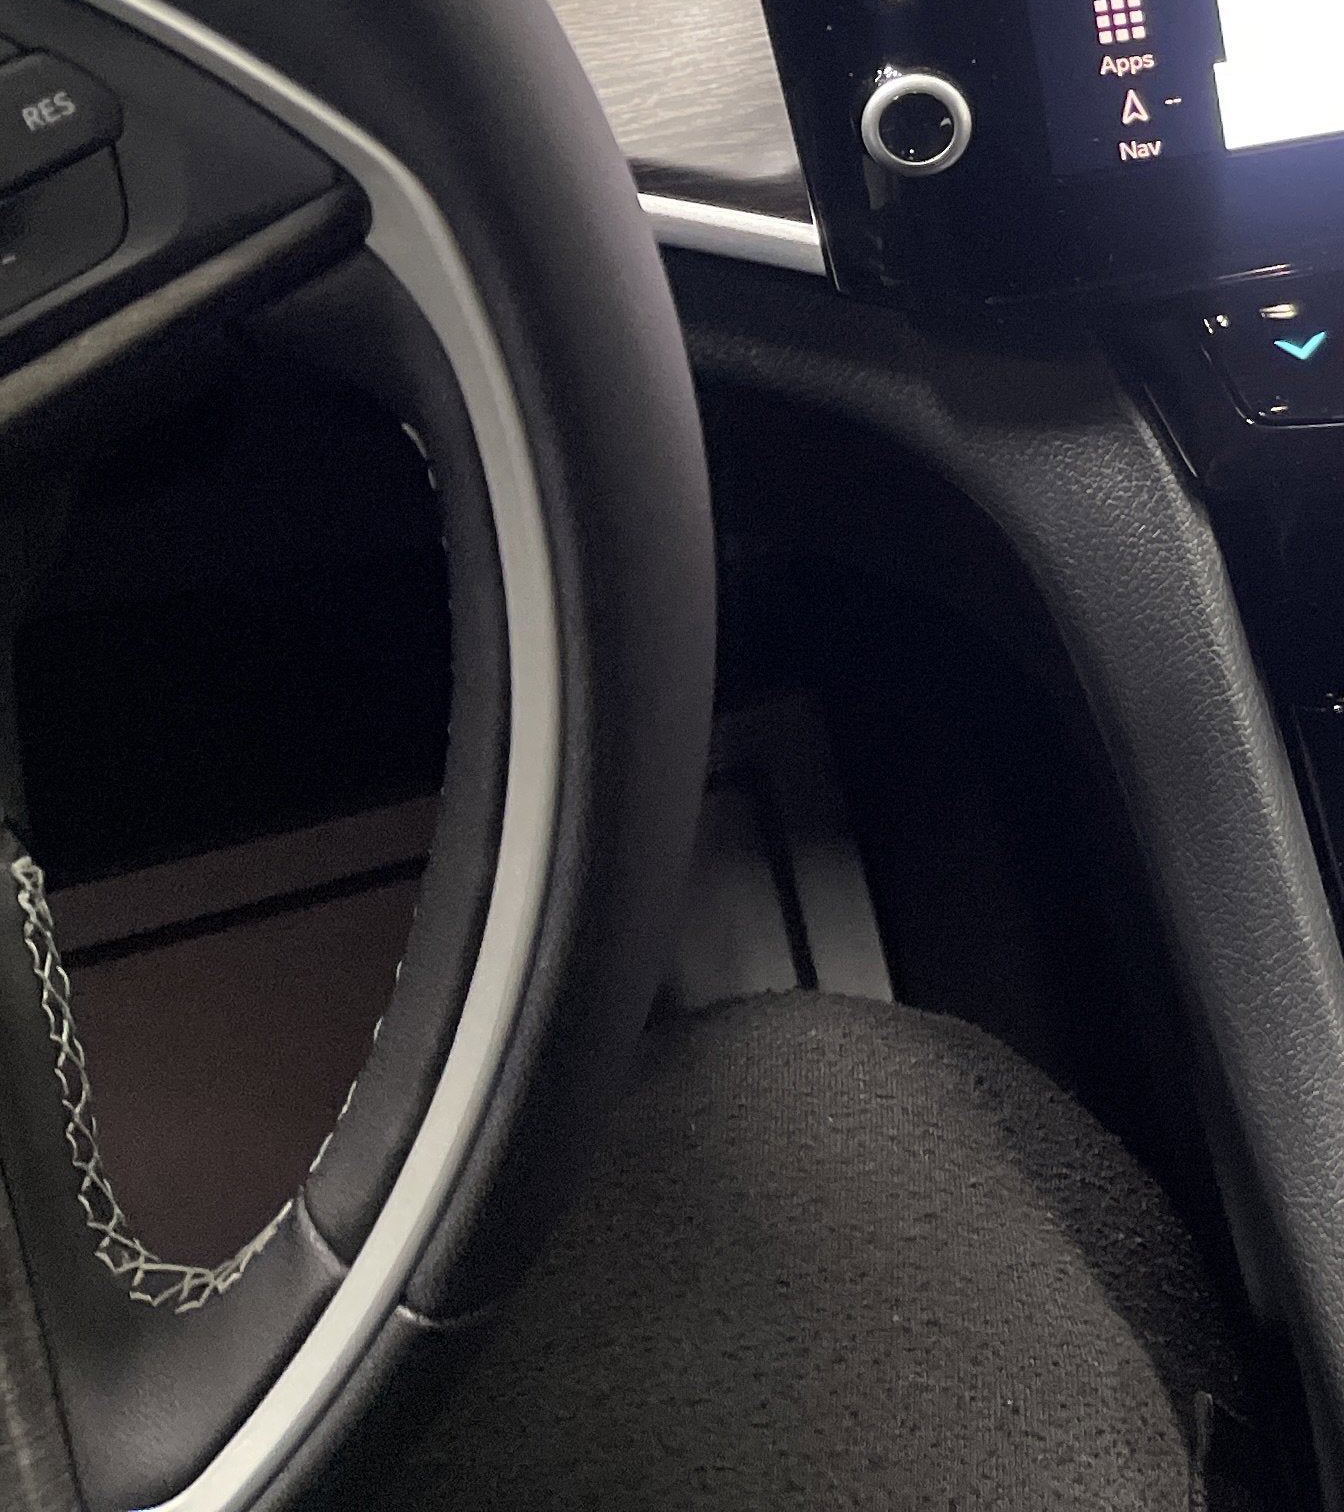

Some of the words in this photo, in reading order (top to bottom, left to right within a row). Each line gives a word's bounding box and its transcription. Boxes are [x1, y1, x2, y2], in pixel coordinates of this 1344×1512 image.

[1100, 51, 1155, 78] Apps
[21, 91, 76, 132] RES
[1119, 138, 1162, 162] Nav
